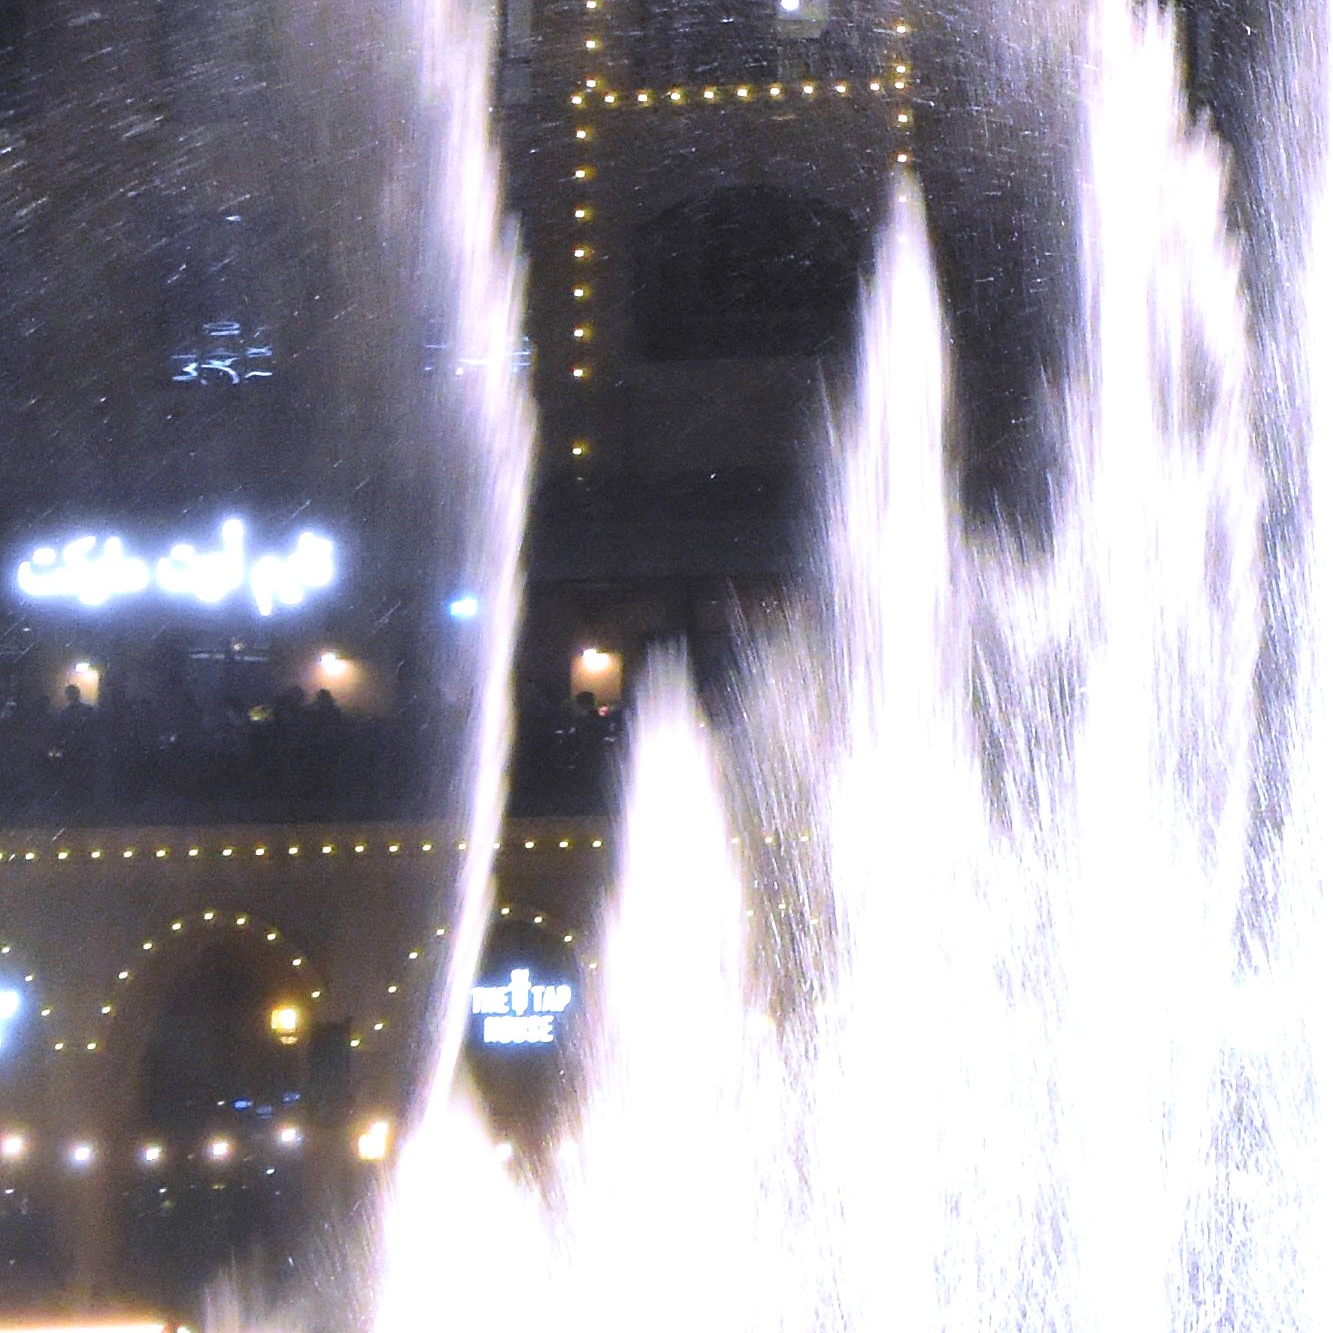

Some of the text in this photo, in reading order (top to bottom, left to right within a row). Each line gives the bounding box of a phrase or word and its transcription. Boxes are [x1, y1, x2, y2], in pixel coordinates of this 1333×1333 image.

[471, 984, 572, 1014] THE TAP
[483, 1014, 554, 1044] HOUSE
